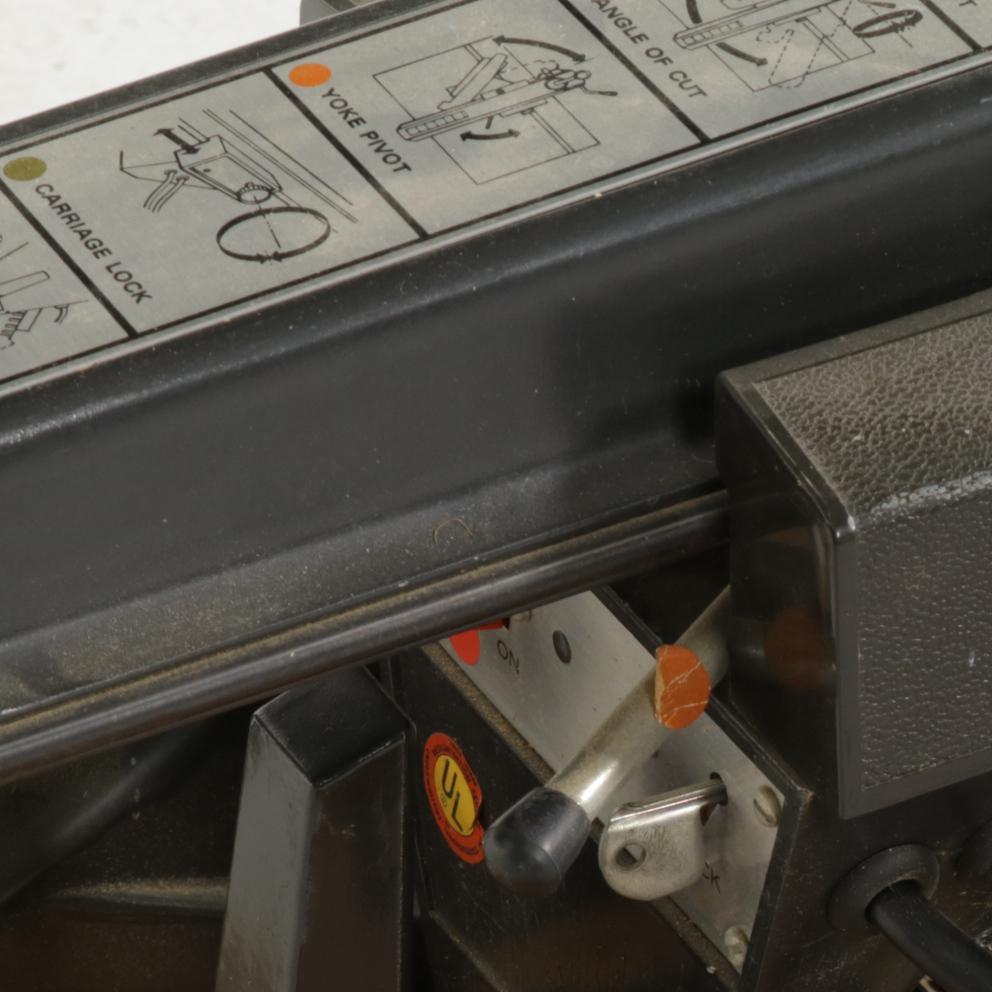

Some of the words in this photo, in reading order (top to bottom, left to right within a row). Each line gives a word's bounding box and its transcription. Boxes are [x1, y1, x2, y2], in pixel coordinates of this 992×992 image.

[590, 0, 649, 44] ANGLE
[645, 47, 673, 66] OF
[668, 70, 707, 98] CUT
[321, 87, 366, 128] YOKE
[360, 130, 412, 172] PIVOT
[35, 184, 113, 259] CARRIAGE
[105, 262, 153, 304] LOCK
[497, 640, 519, 675] ON
